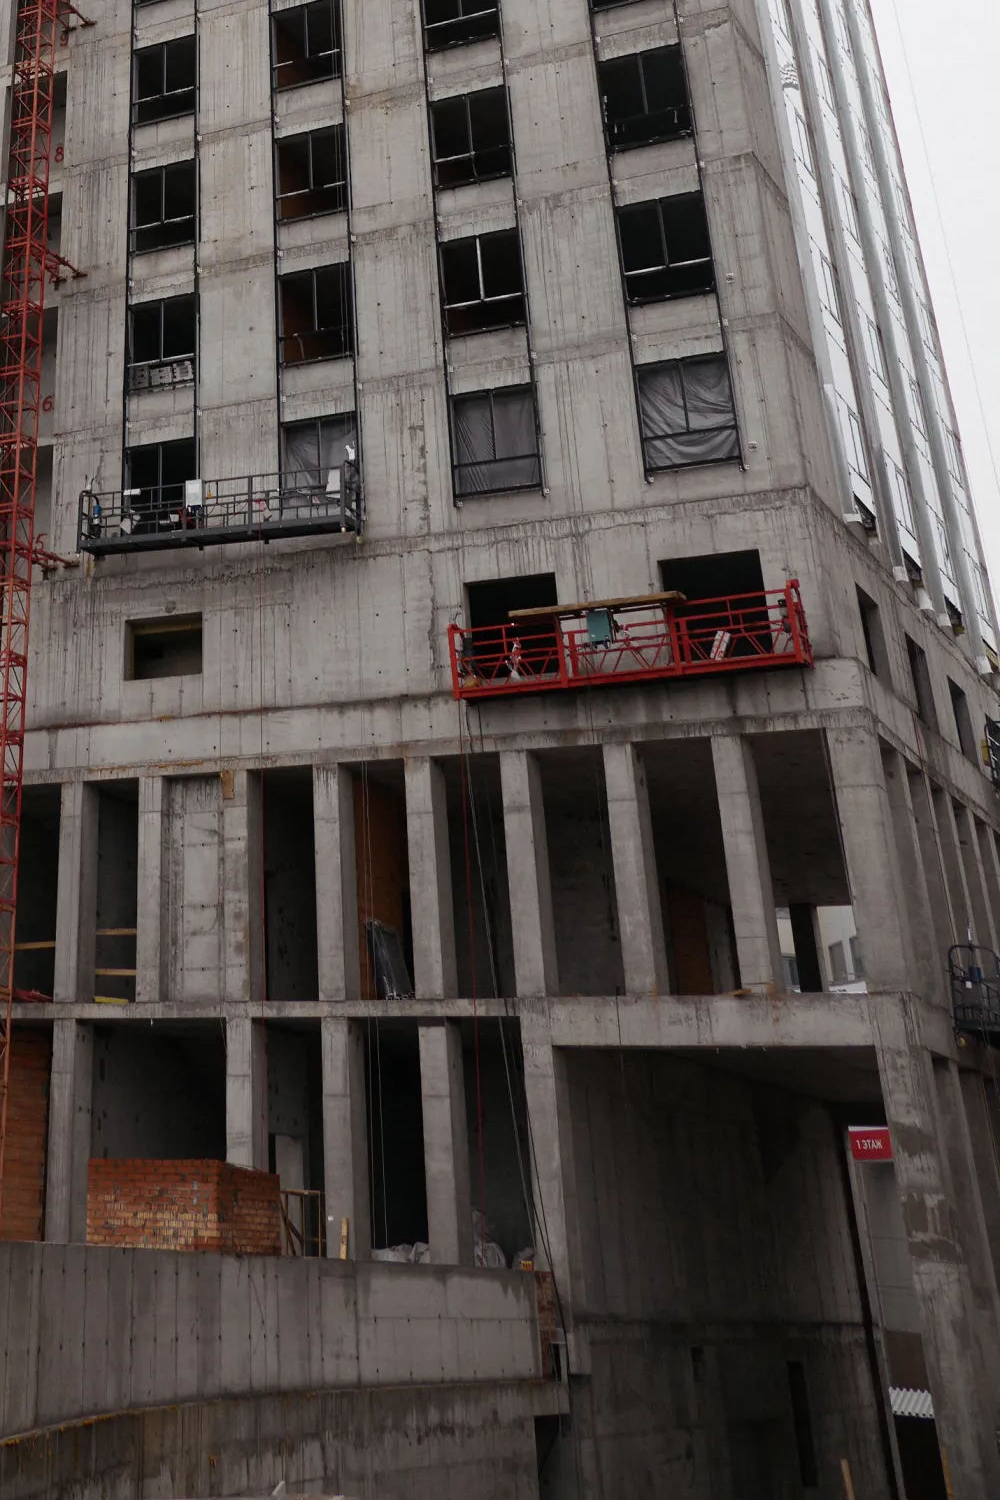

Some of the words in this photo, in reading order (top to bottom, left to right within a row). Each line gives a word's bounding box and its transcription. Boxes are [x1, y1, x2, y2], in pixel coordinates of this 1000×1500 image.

[54, 146, 65, 163] 8
[42, 395, 53, 412] 6
[862, 1139, 884, 1150] ЭТАЖ
